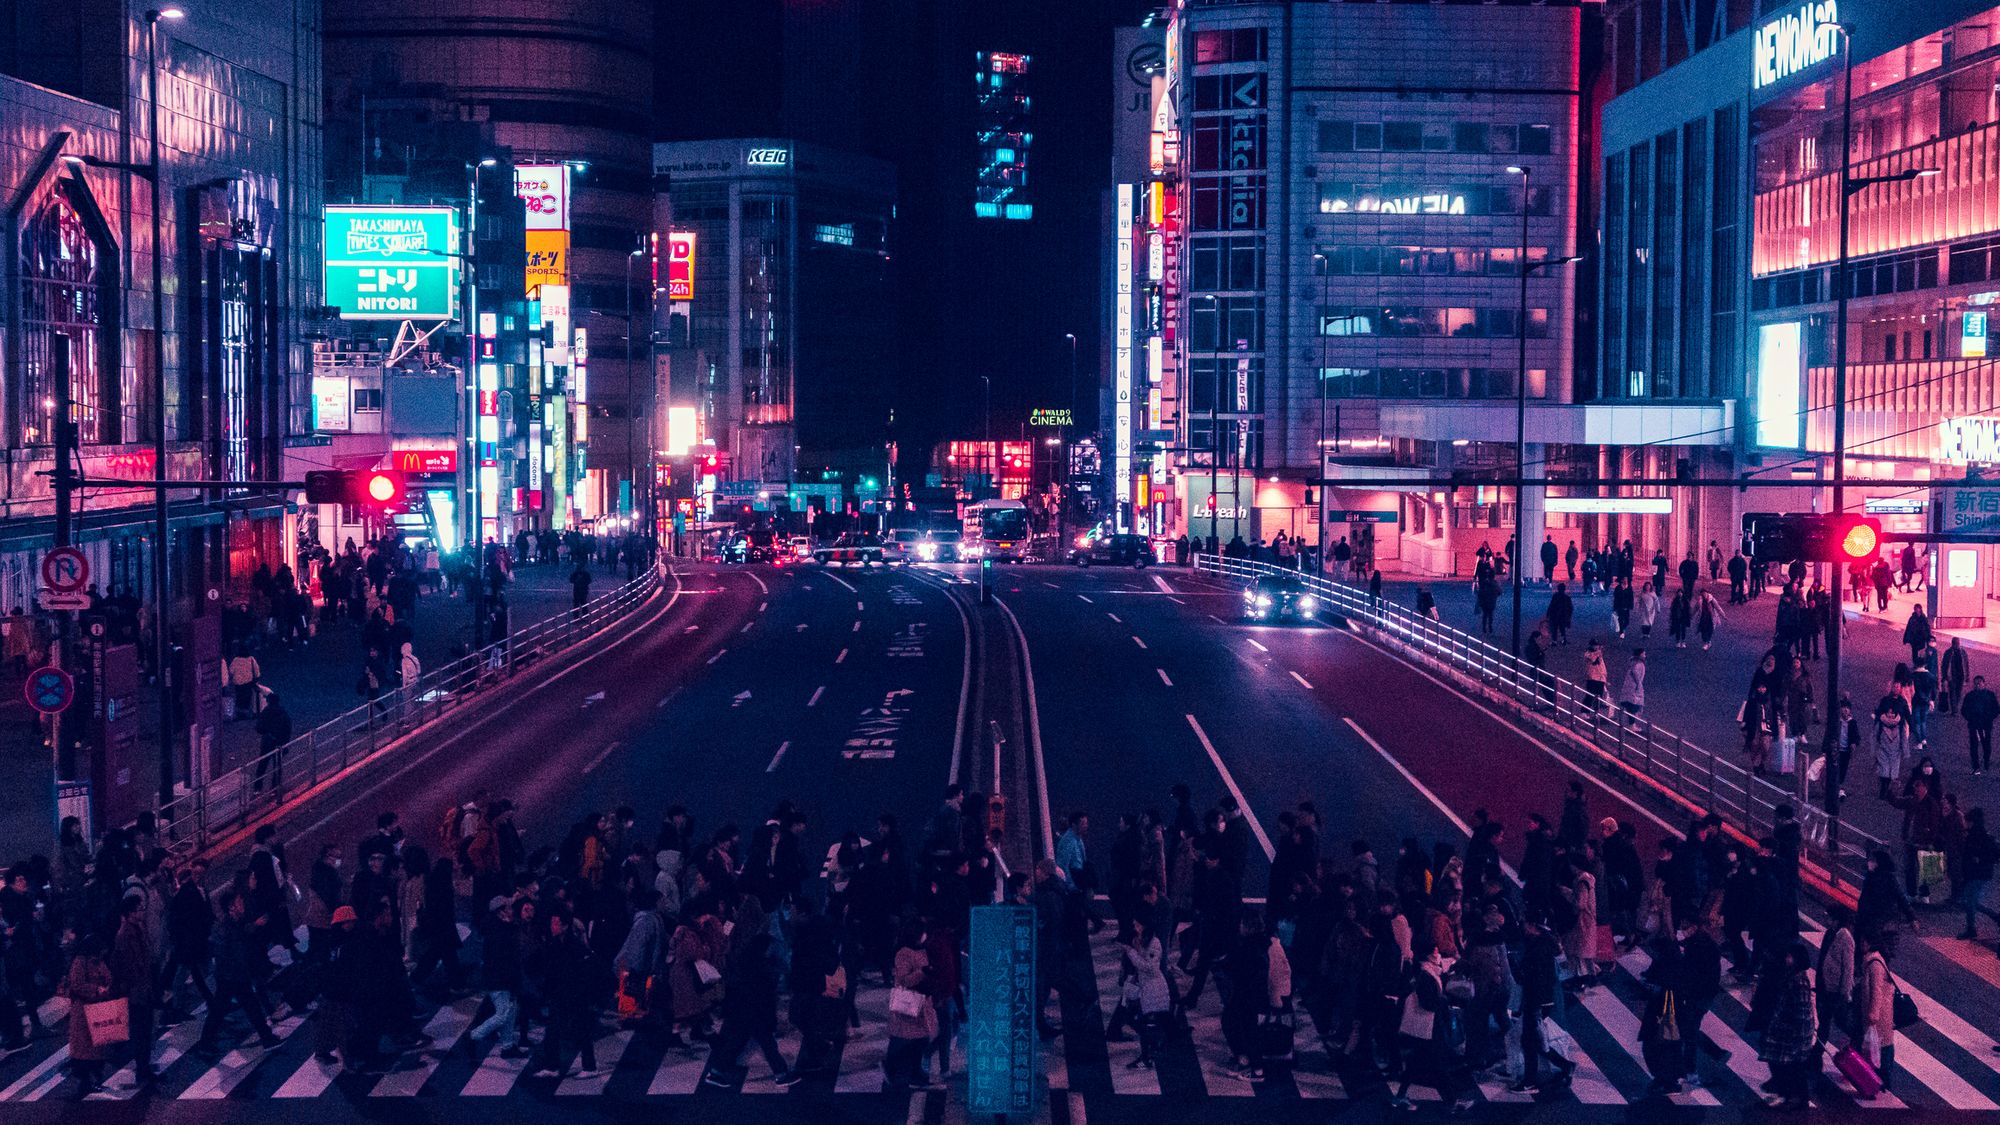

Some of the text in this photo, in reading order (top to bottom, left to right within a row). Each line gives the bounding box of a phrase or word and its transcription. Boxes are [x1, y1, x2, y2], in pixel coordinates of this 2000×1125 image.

[748, 149, 787, 165] KEIO
[1233, 76, 1257, 223] Victoria
[656, 161, 731, 173] www.keio.co.jp
[349, 219, 424, 233] TAKASHIMAYA
[350, 235, 424, 257] TIMES SQUARE
[358, 269, 417, 293] ニトリ
[358, 297, 417, 310] NITORI
[1030, 416, 1073, 426] CINEMA
